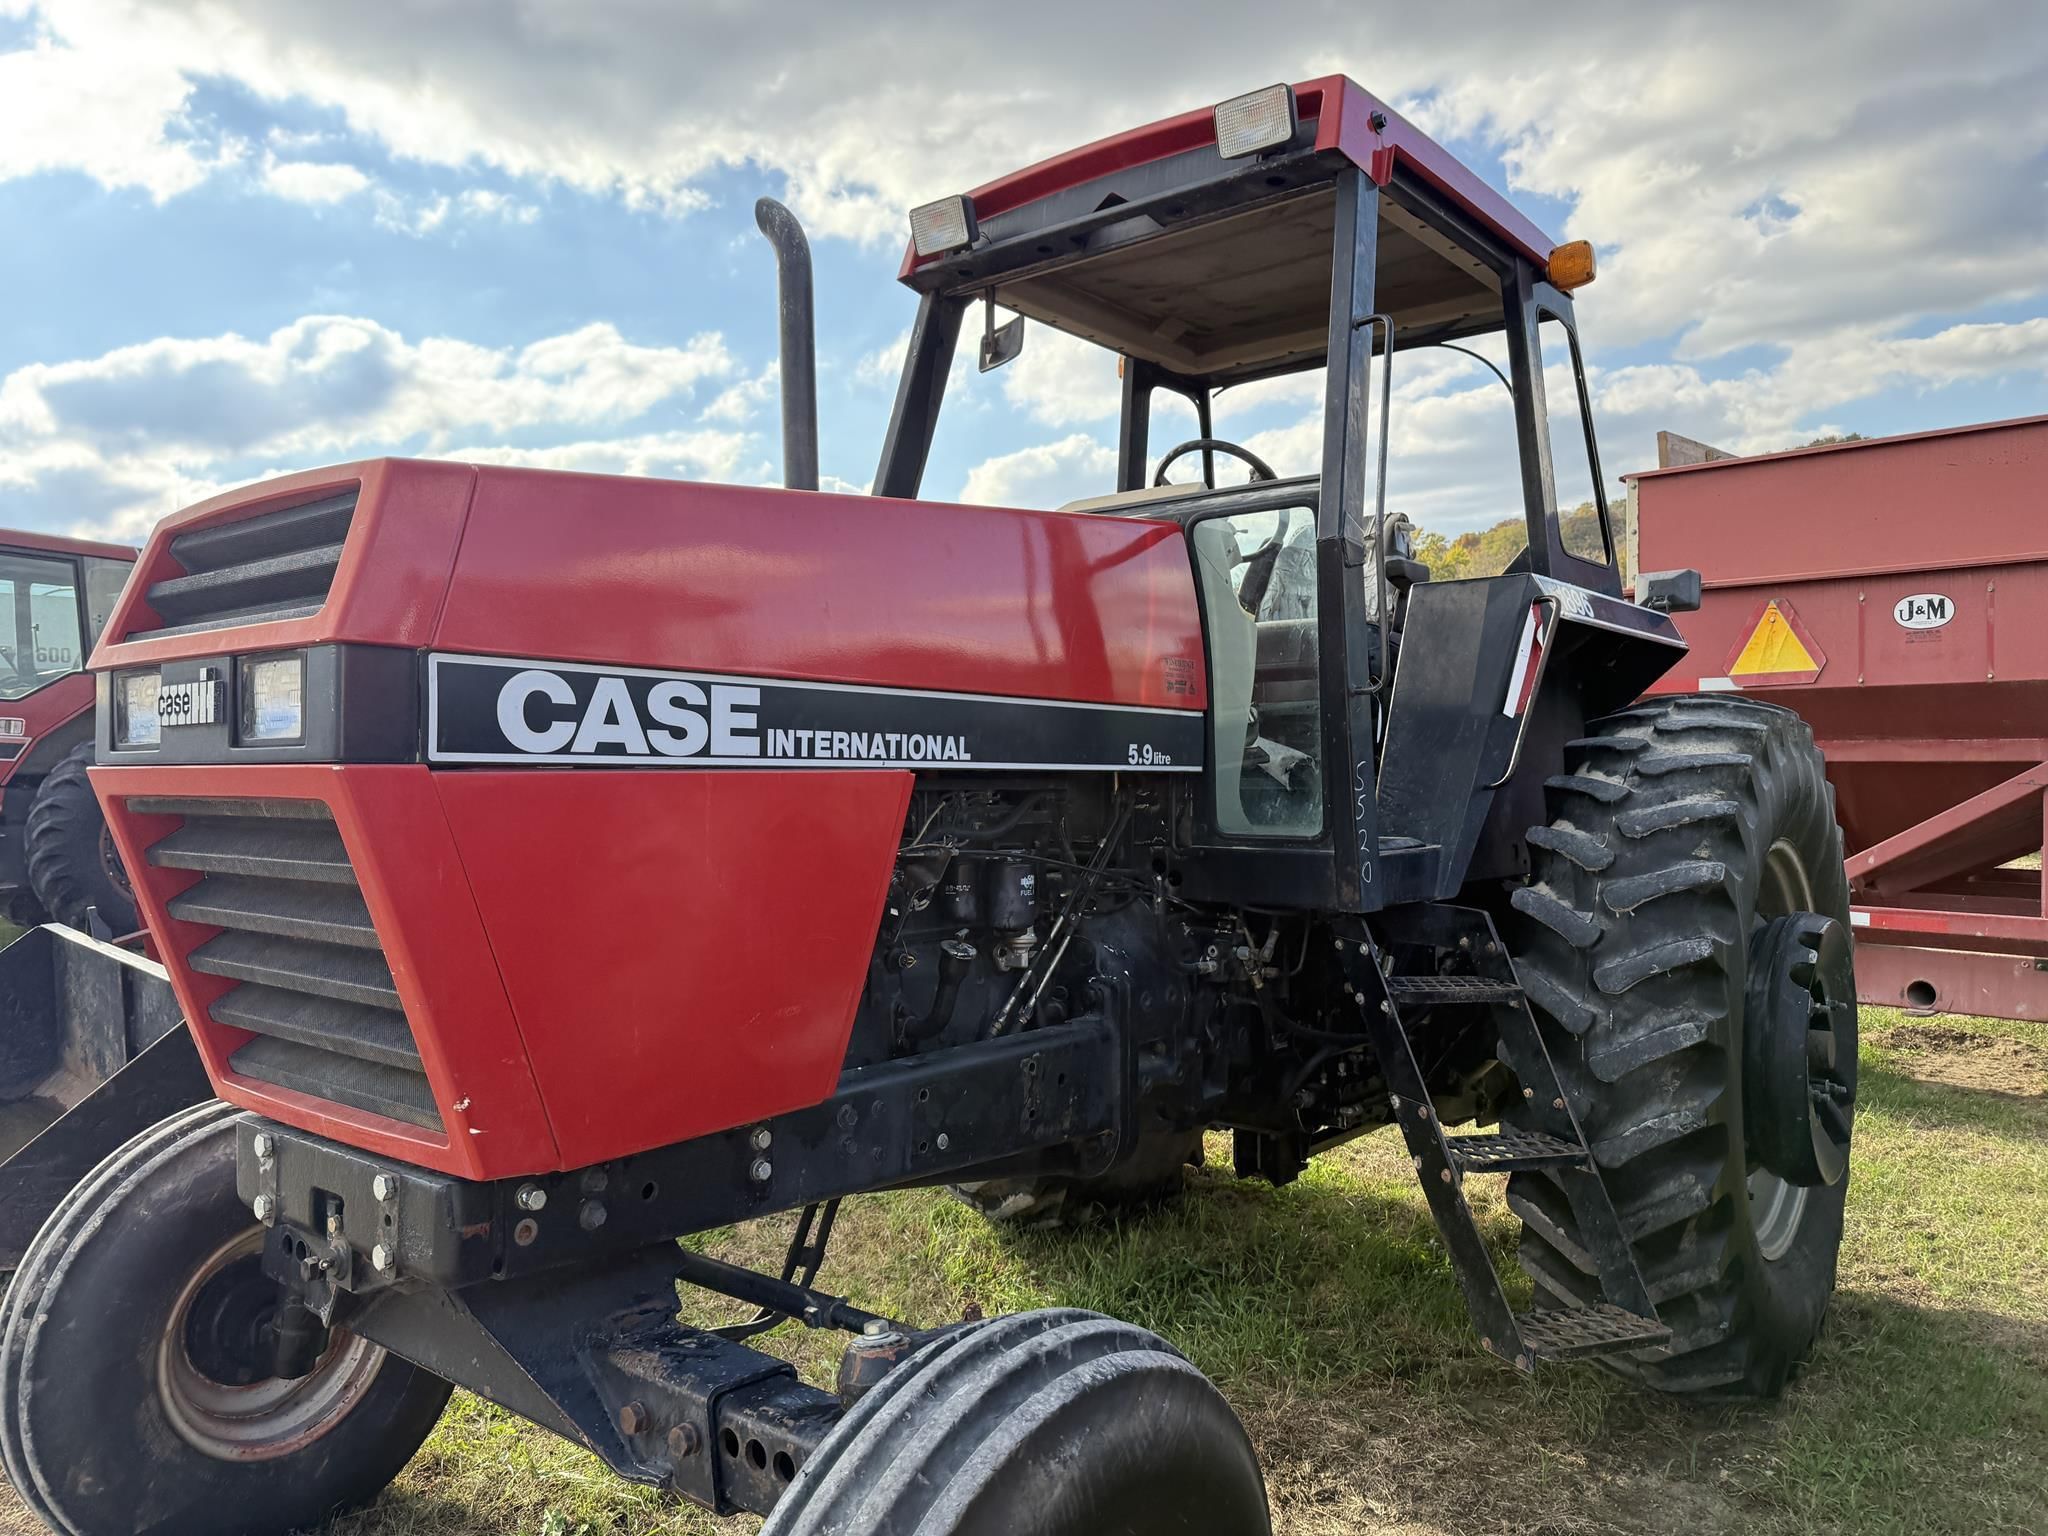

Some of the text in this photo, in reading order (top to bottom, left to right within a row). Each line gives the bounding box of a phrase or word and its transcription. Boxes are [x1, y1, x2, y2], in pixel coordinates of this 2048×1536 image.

[1899, 598, 1946, 621] J&M
[496, 669, 971, 760] CASE INTERNATIONAL
[1128, 744, 1171, 765] 5.9 litre
